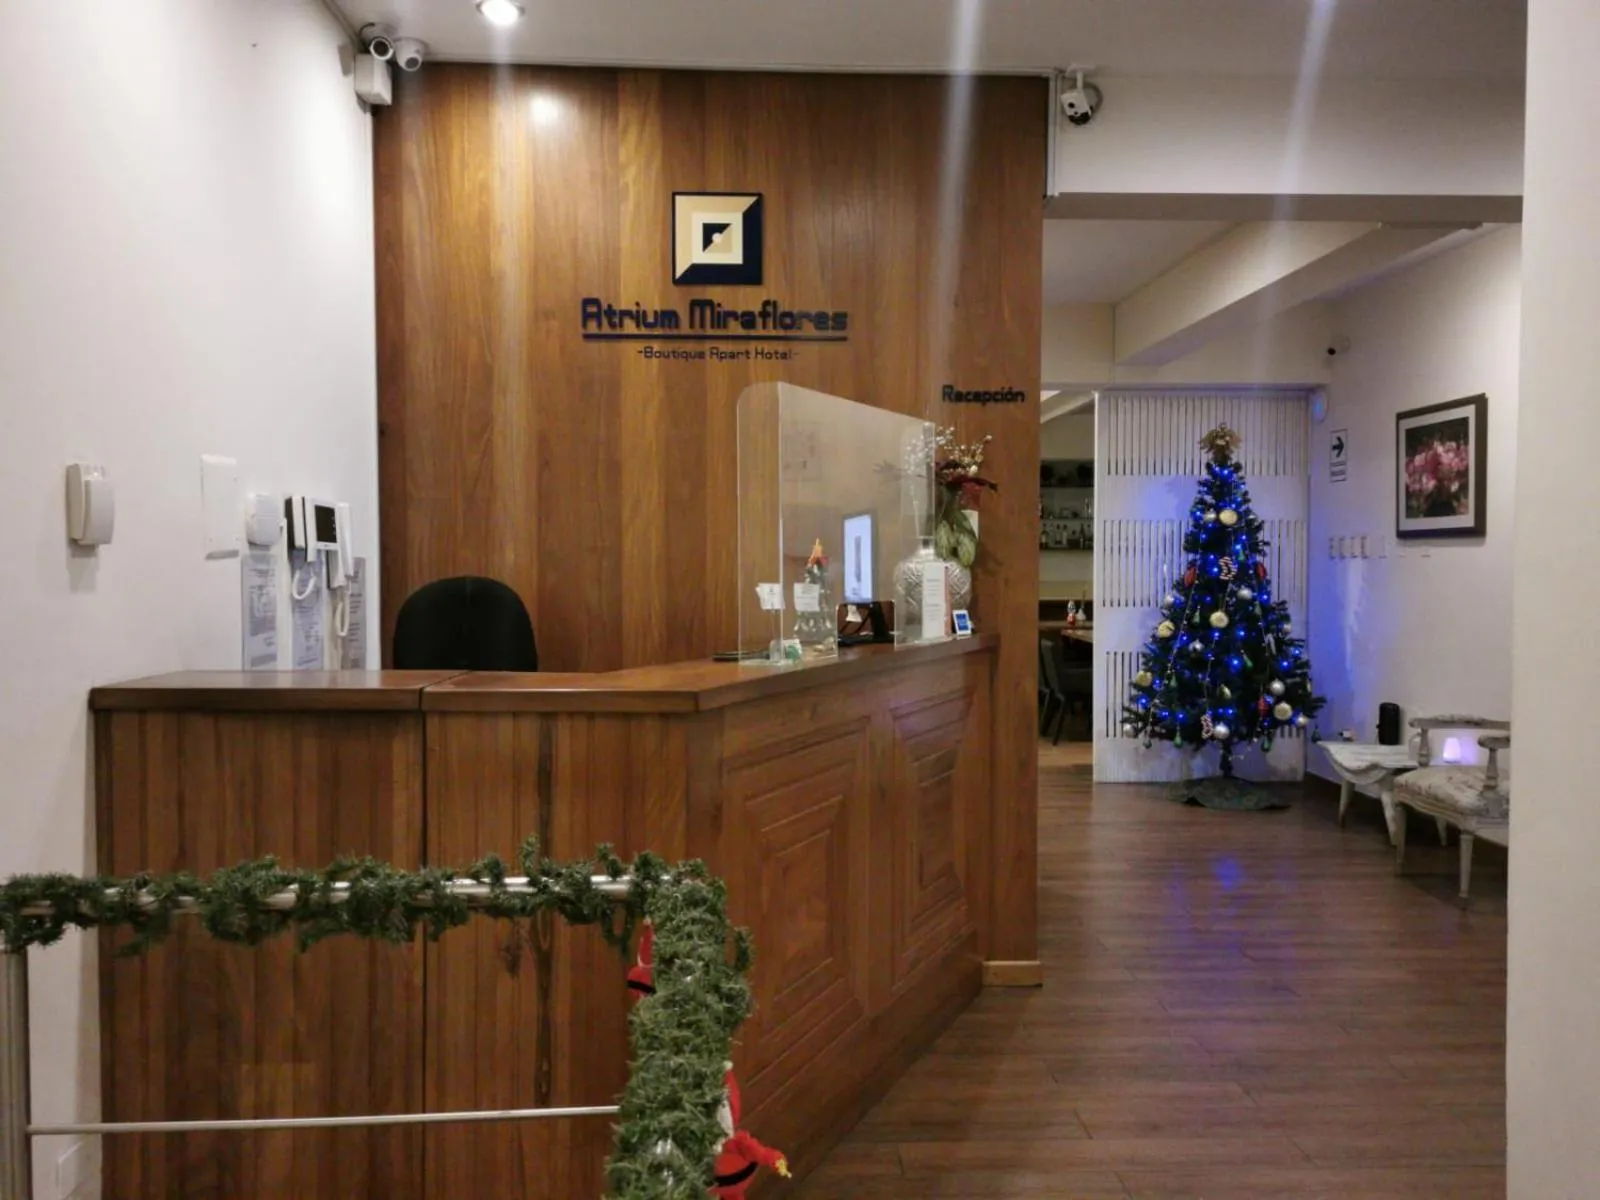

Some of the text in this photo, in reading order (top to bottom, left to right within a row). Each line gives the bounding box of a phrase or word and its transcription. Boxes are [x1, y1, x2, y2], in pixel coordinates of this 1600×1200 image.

[581, 297, 848, 331] Atrium Miraflores
[709, 346, 751, 362] Apart
[942, 384, 1025, 406] Recepción
